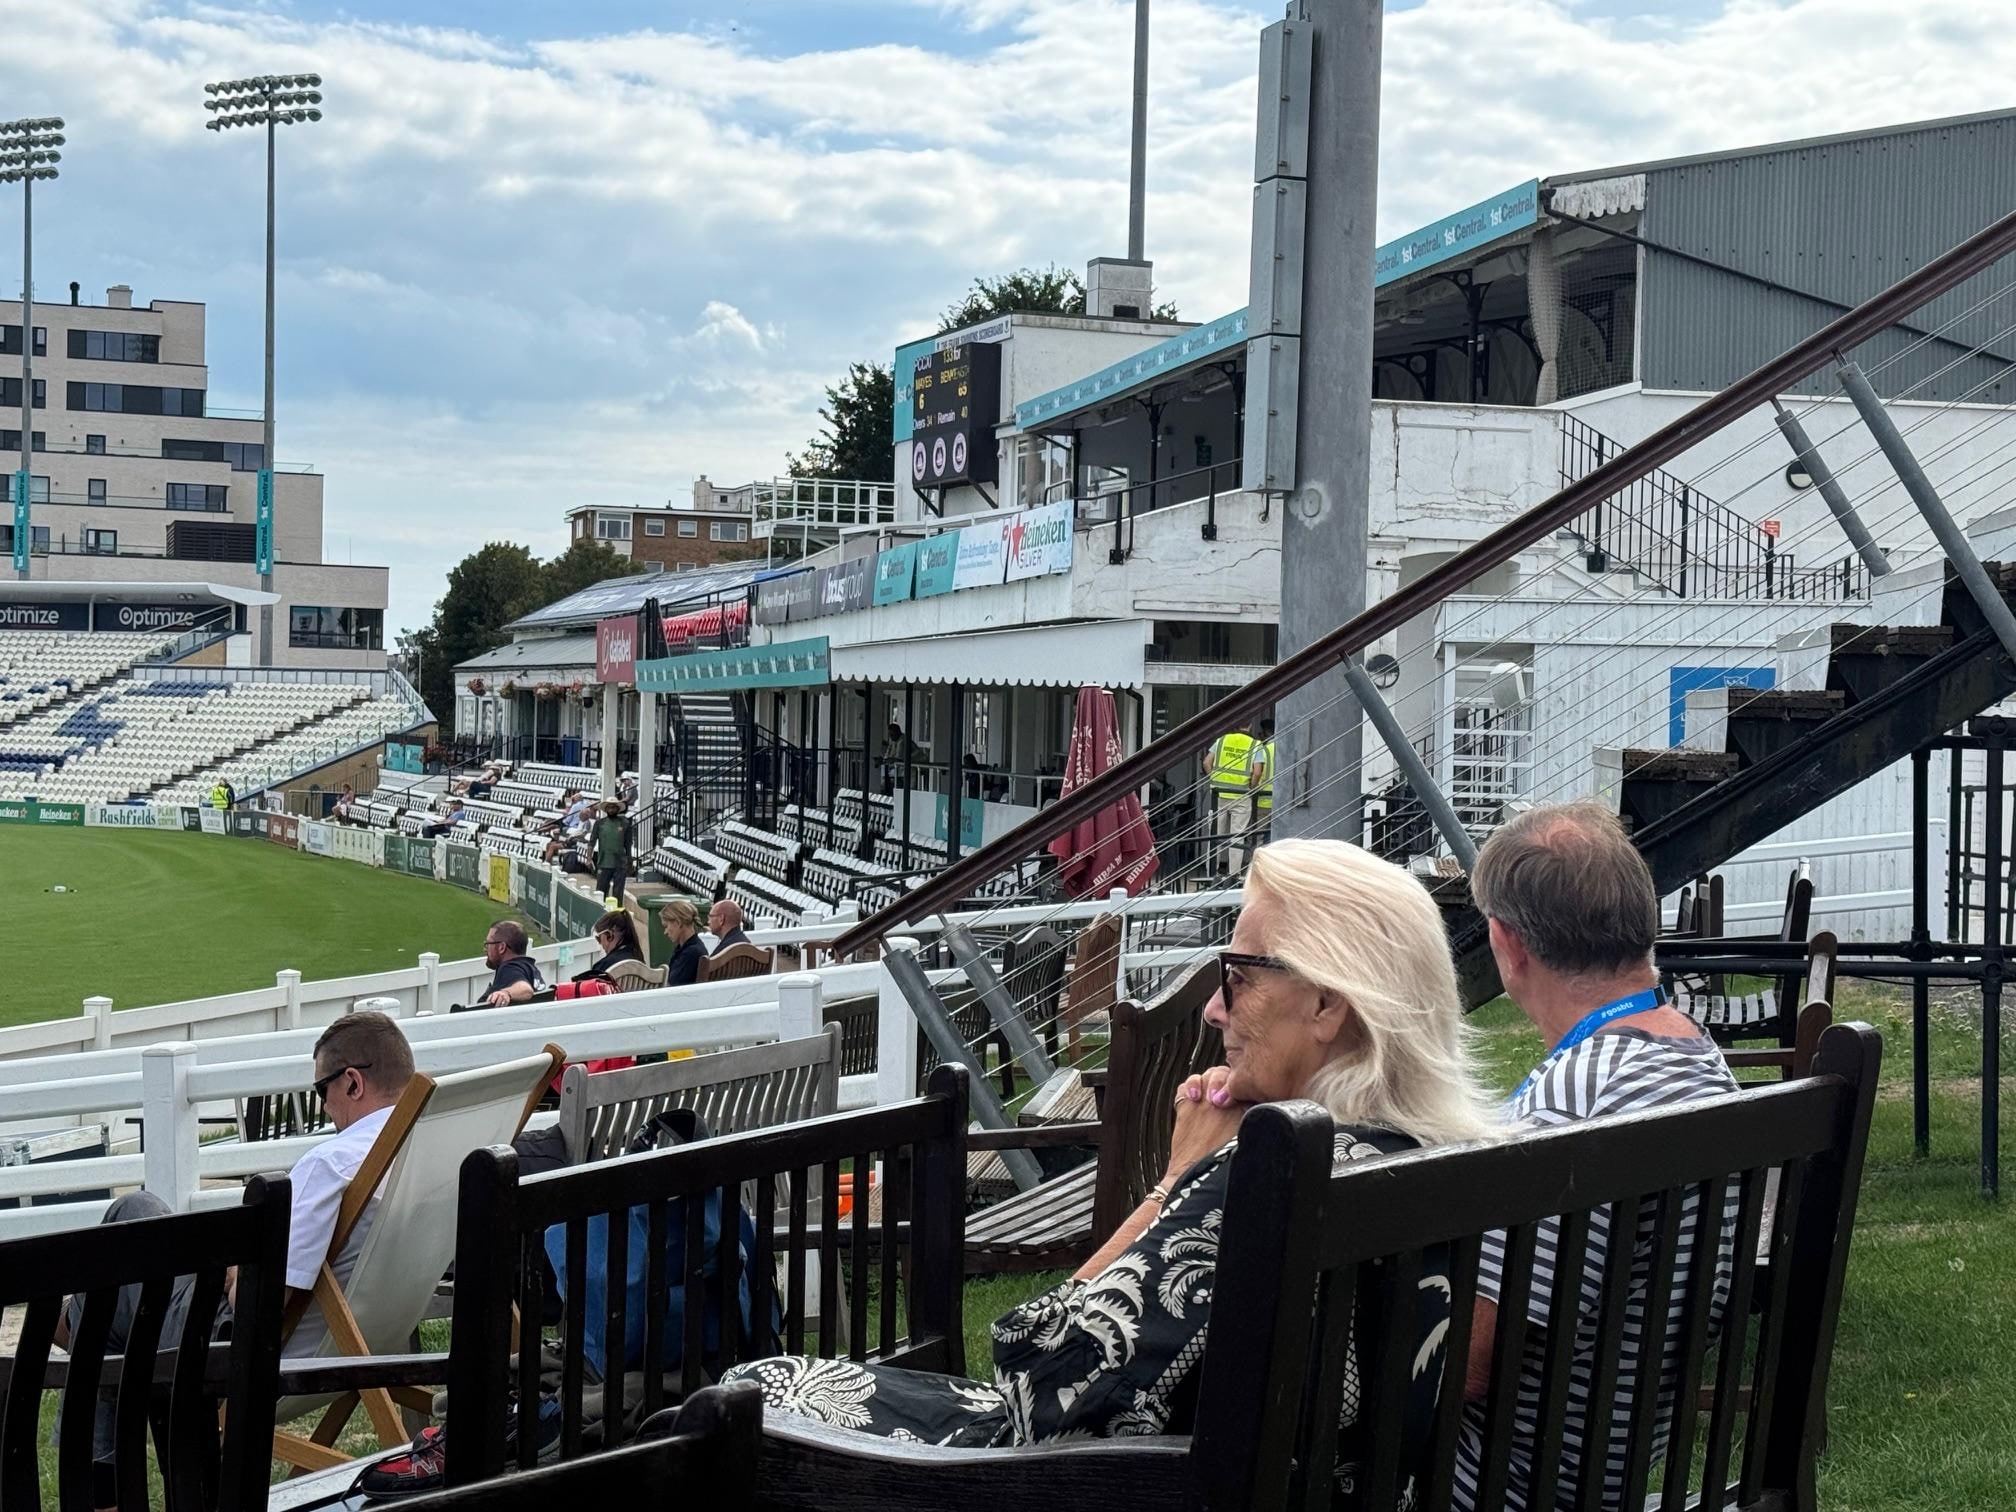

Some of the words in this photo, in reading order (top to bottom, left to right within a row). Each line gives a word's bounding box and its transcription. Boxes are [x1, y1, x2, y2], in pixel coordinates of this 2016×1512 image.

[1020, 518, 1067, 551] Heineken
[119, 606, 194, 629] Optimize
[39, 808, 72, 821] Heineken
[100, 808, 156, 826] Rushfields
[1600, 1001, 1634, 1019] #gosbts
